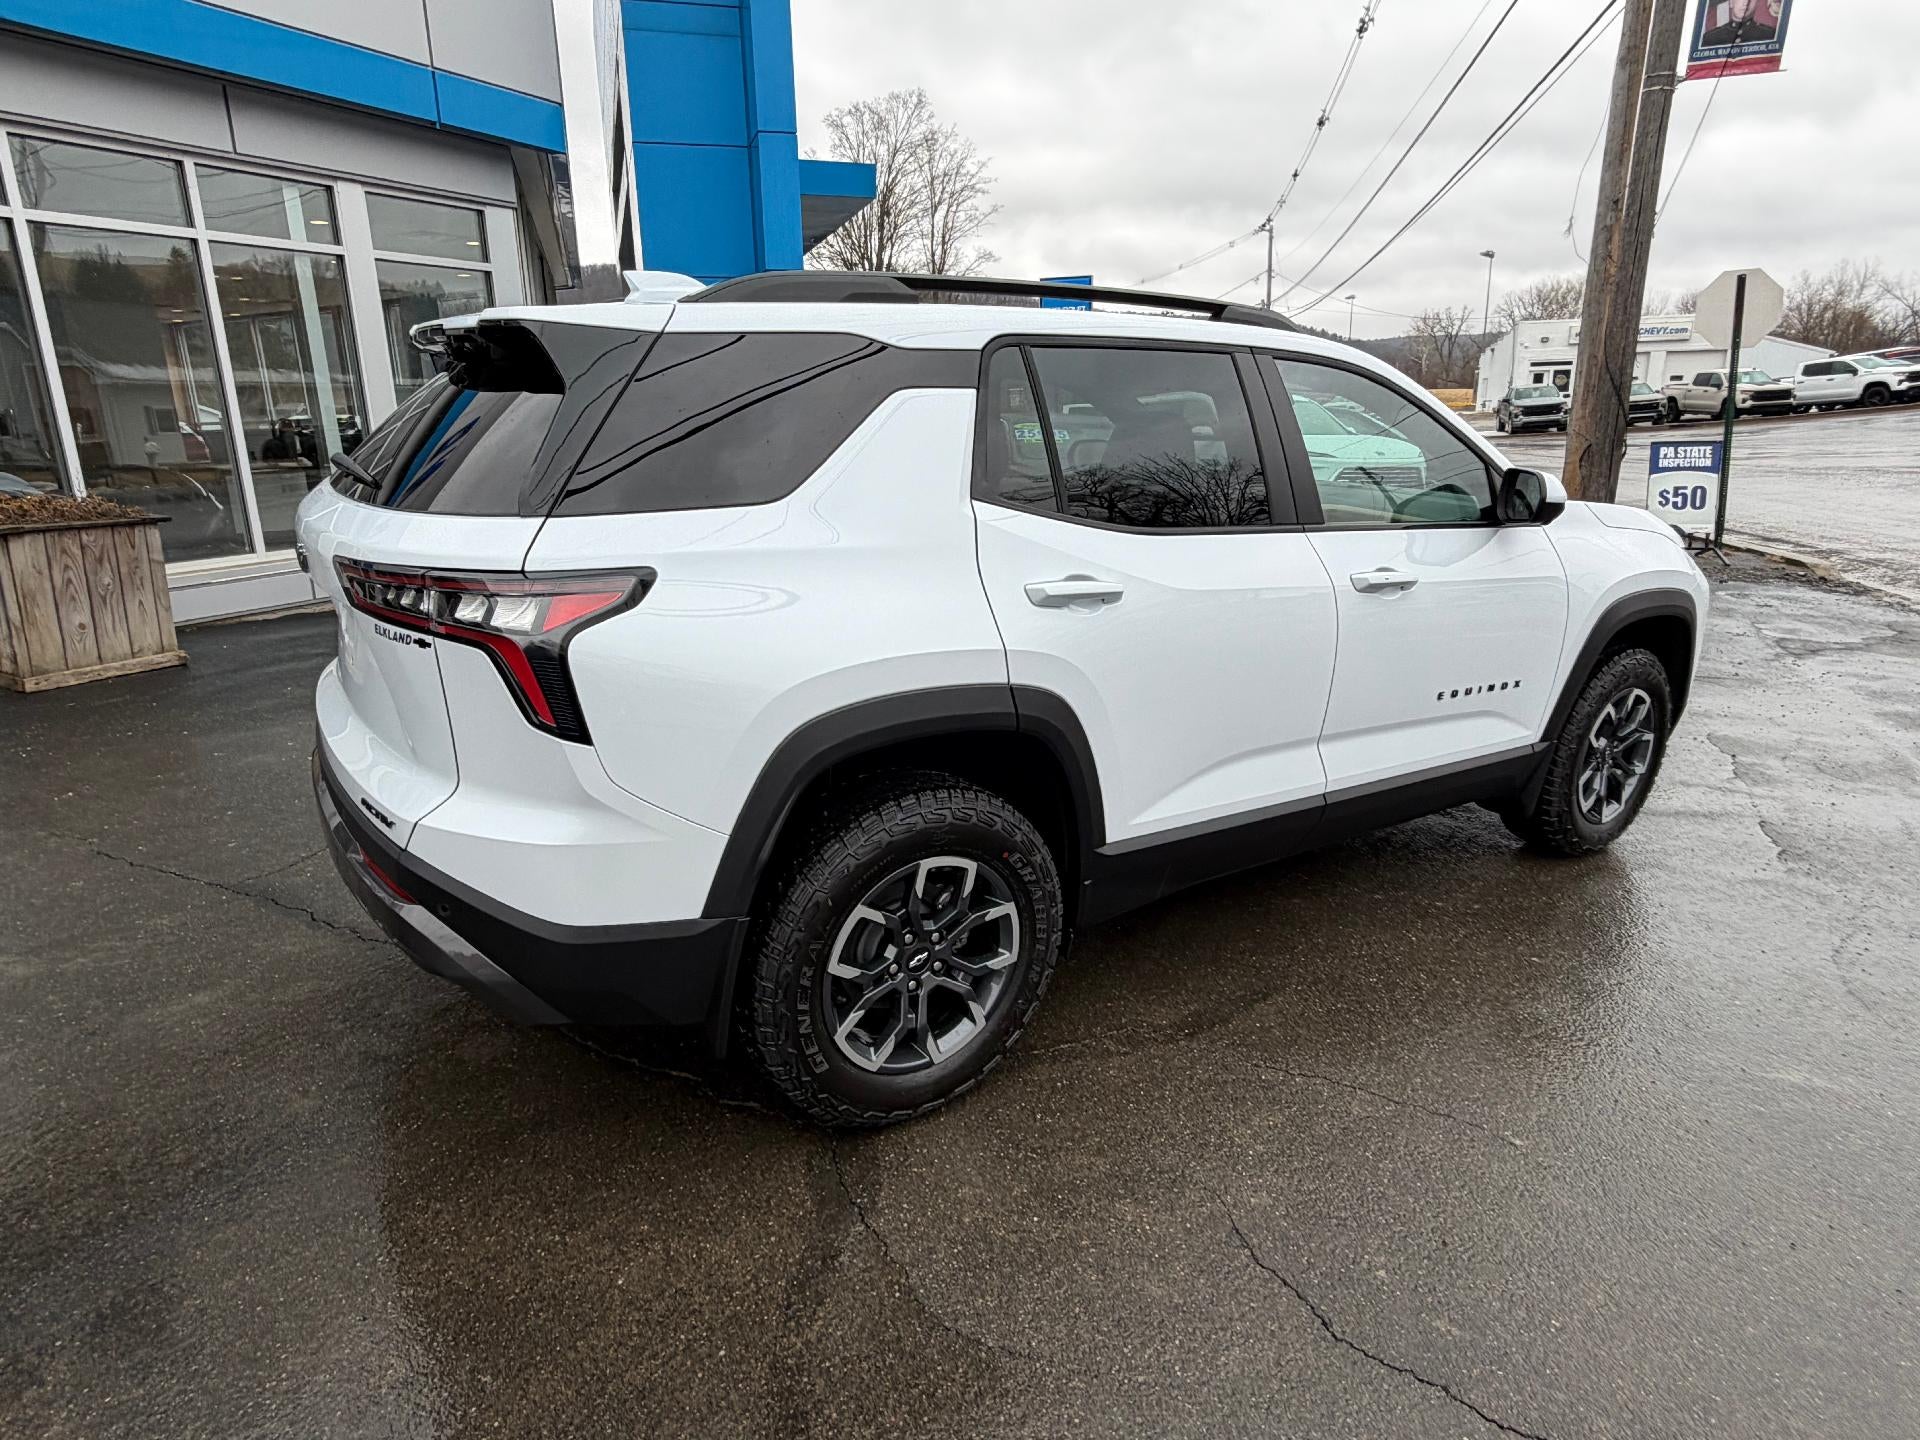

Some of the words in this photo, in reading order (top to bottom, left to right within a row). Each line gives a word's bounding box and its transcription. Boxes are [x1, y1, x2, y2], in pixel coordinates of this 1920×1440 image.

[1693, 49, 1716, 58] GLOBAL
[1659, 446, 1675, 458] PA
[1677, 445, 1713, 458] STATE
[1658, 457, 1712, 468] INSPECTION
[1657, 485, 1708, 511] $50
[374, 623, 412, 646] ELKLAND
[1436, 679, 1522, 701] EQUINOX
